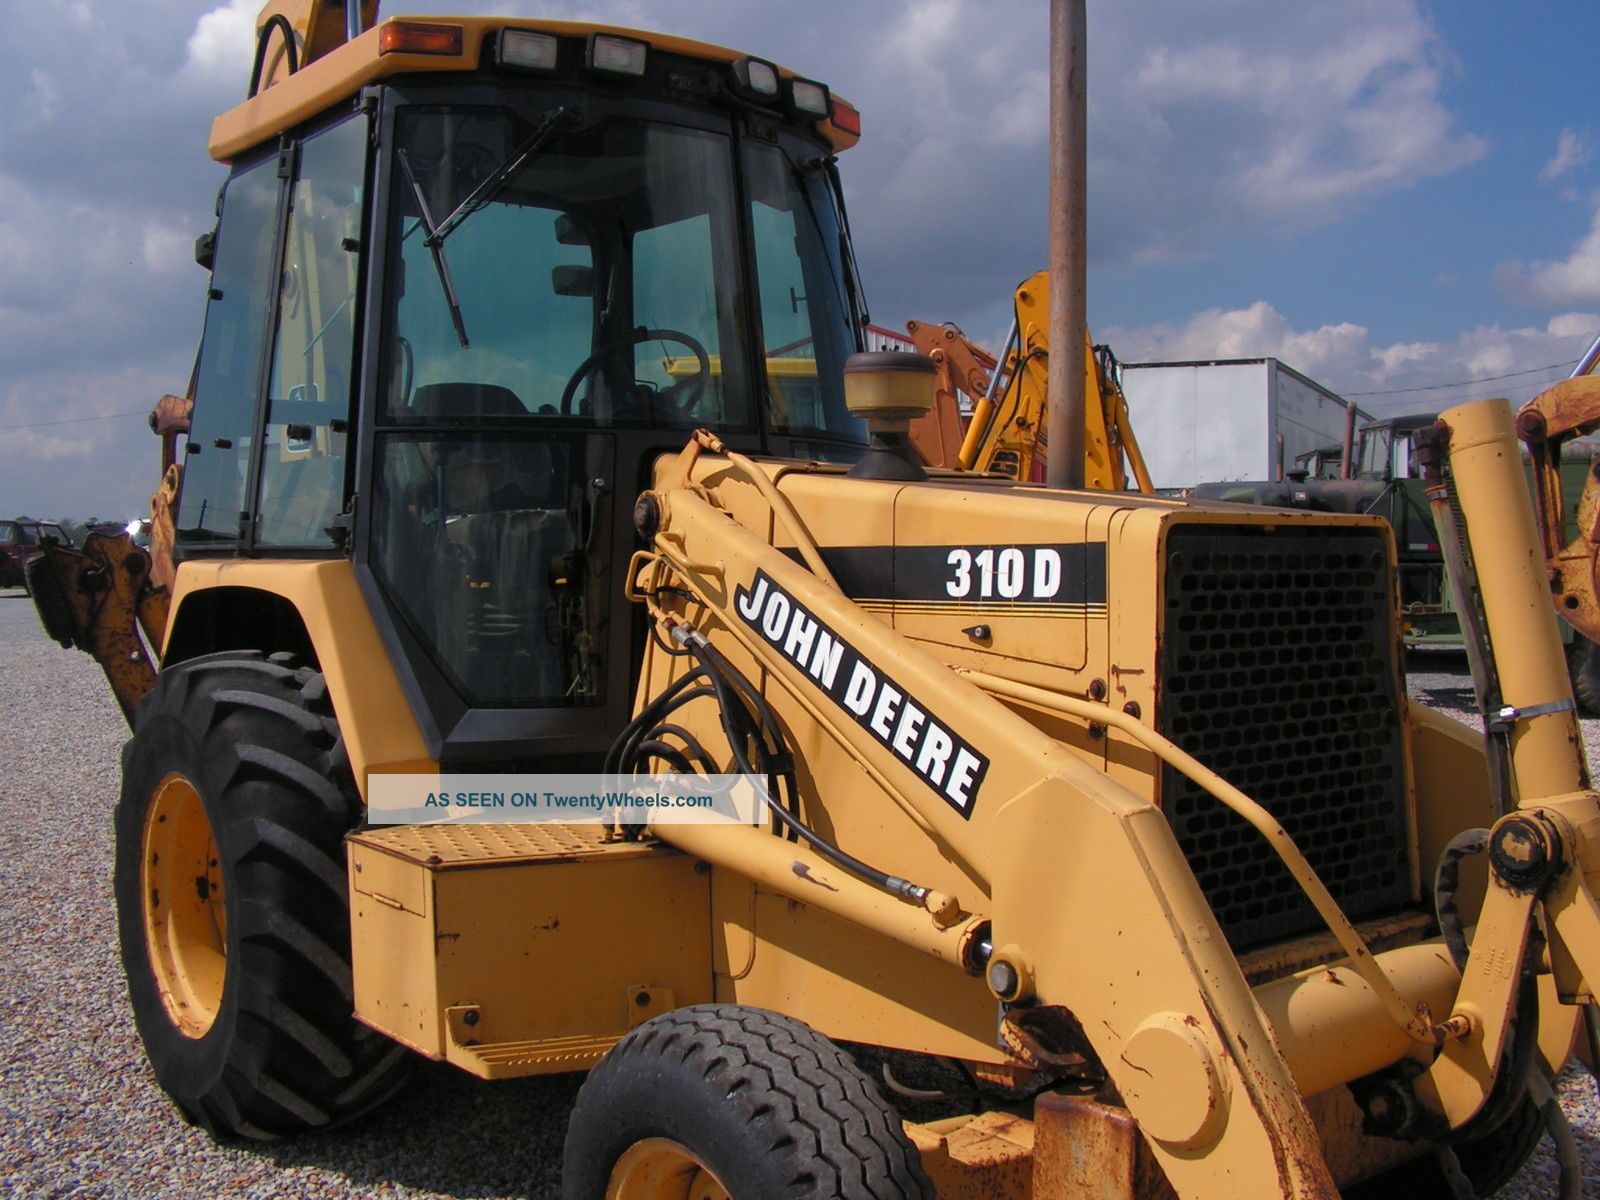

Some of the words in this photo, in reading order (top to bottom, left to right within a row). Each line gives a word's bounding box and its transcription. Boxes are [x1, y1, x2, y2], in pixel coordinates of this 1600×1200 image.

[946, 548, 1025, 598] 310
[1033, 548, 1062, 598] D
[738, 577, 846, 691] JOHN
[843, 658, 981, 808] DEERE
